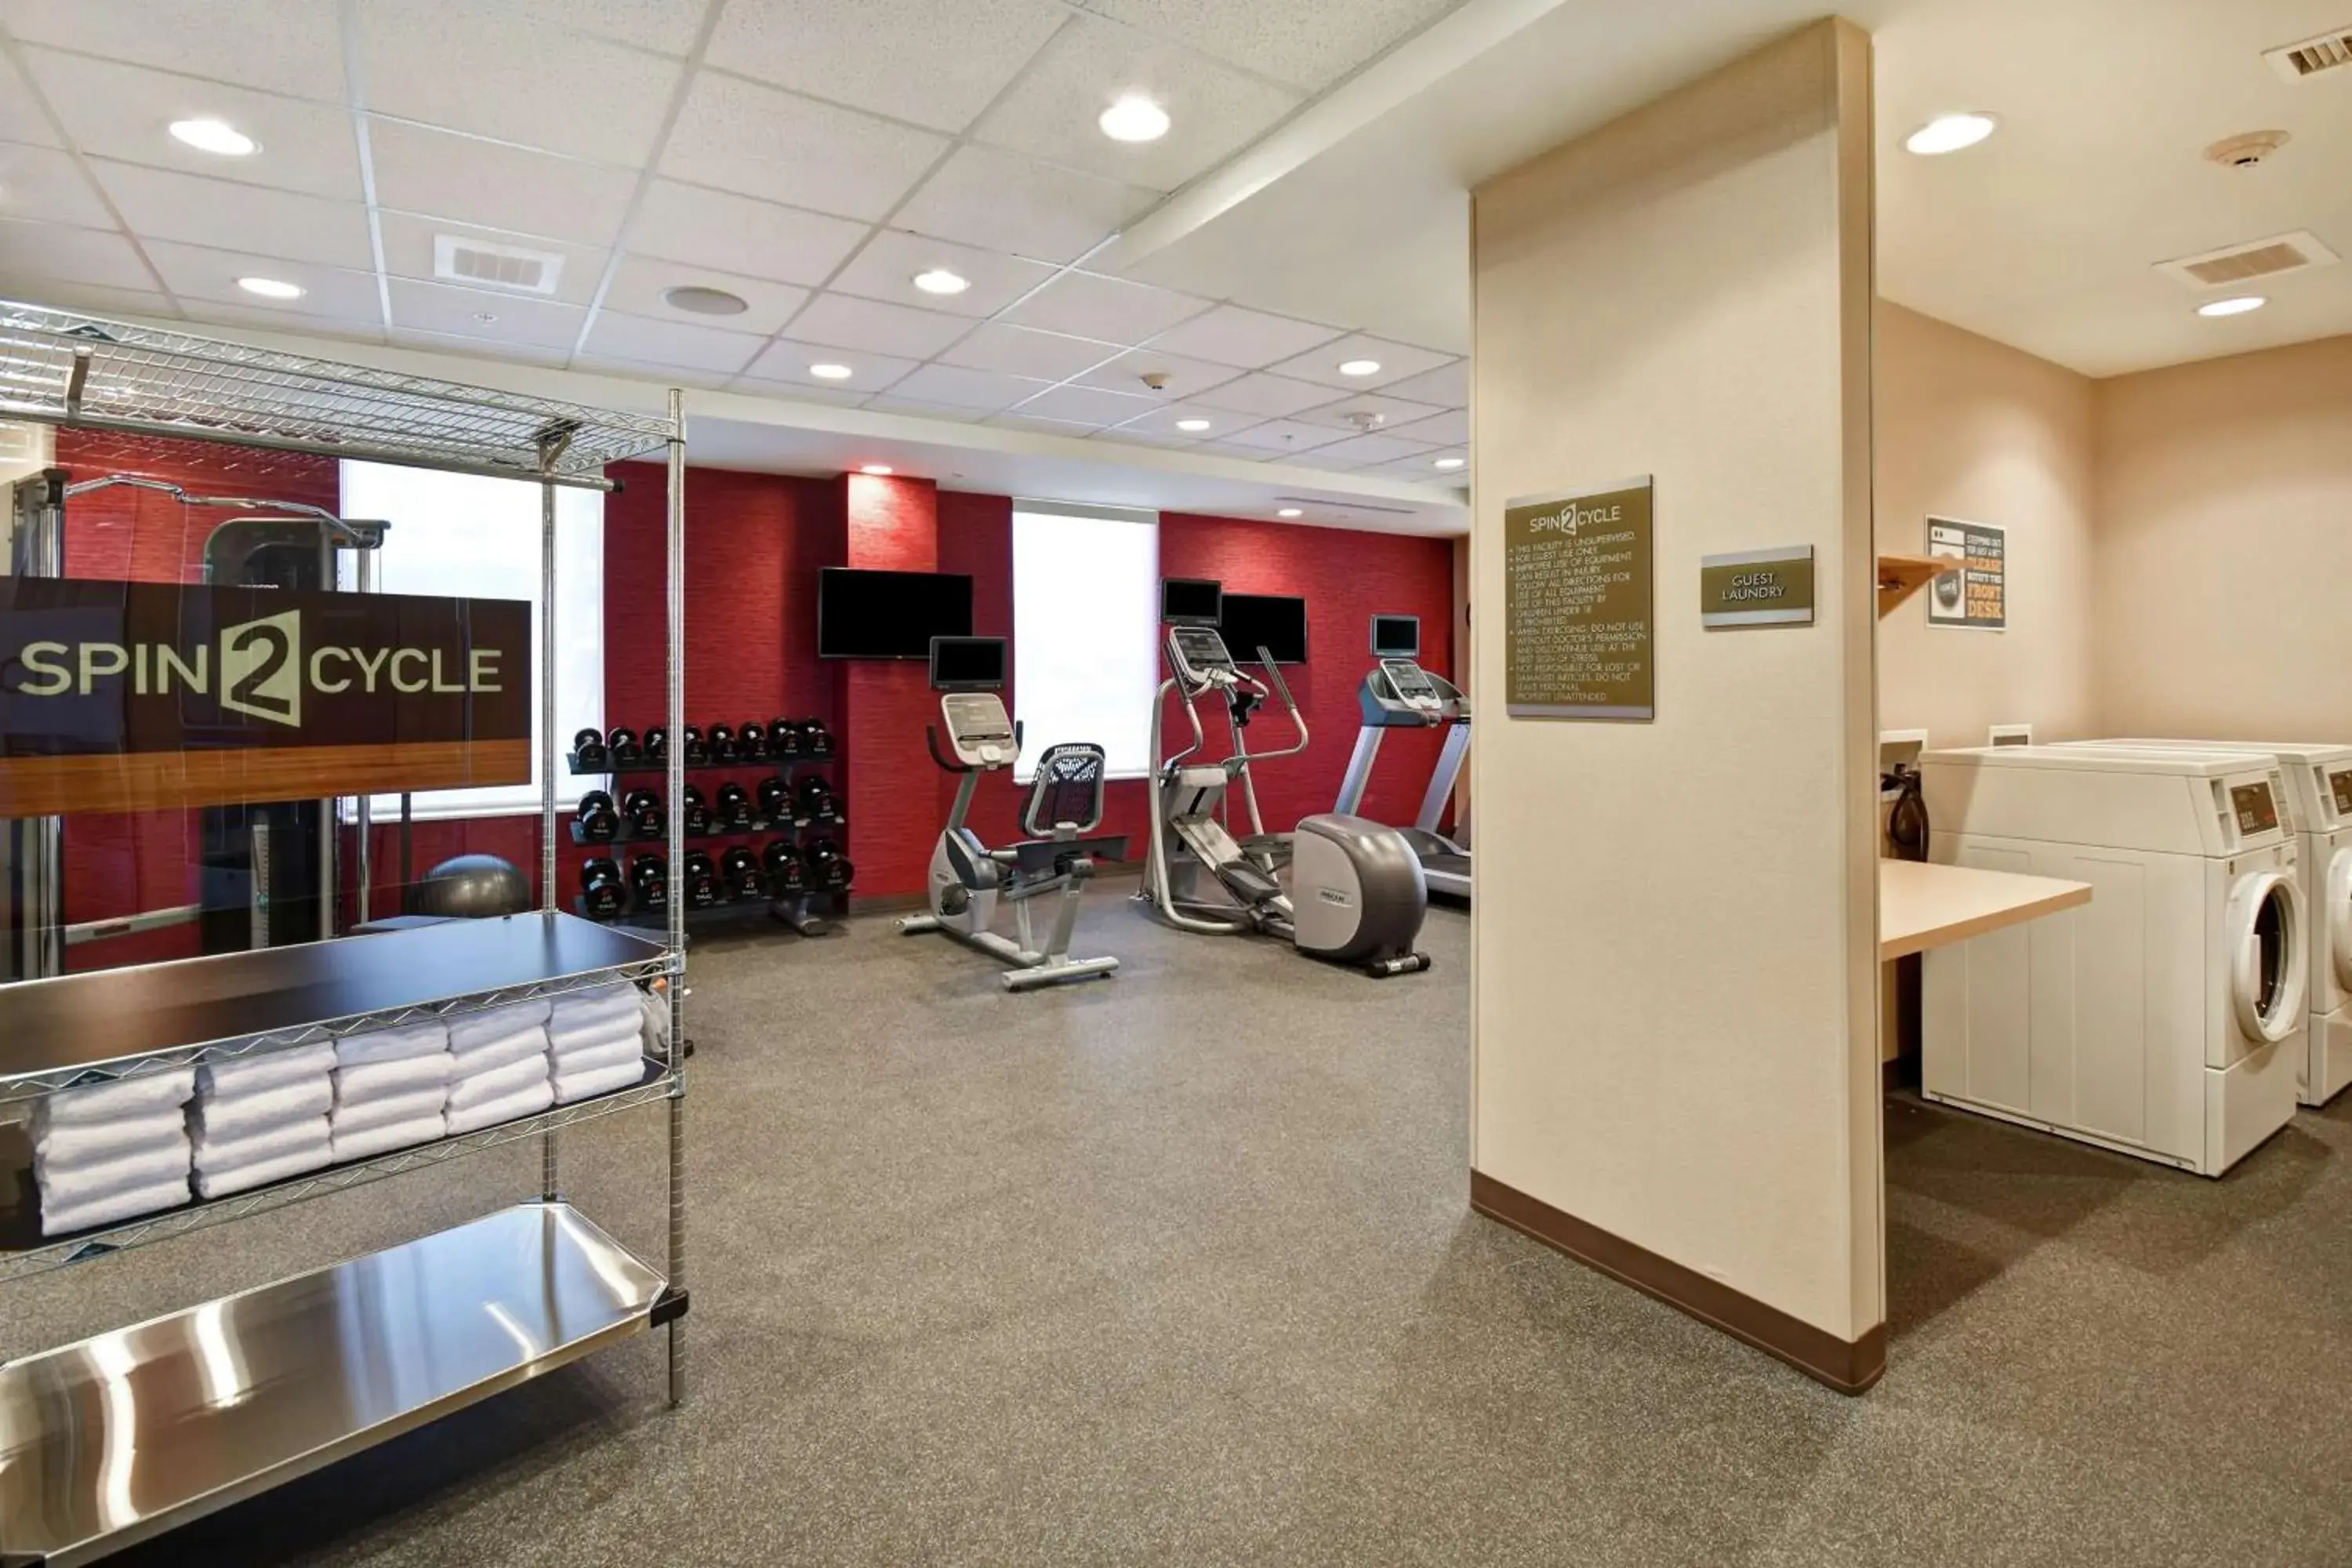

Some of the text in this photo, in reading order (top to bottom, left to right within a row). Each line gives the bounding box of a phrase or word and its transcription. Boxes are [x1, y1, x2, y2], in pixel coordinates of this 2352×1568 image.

[1530, 516, 1559, 532] SPIN
[1577, 506, 1621, 528] CYCLE
[1732, 573, 1774, 586] GUEST
[1722, 586, 1784, 601] LAUNDRY
[17, 624, 503, 716] SPIN 2 CYCLE
